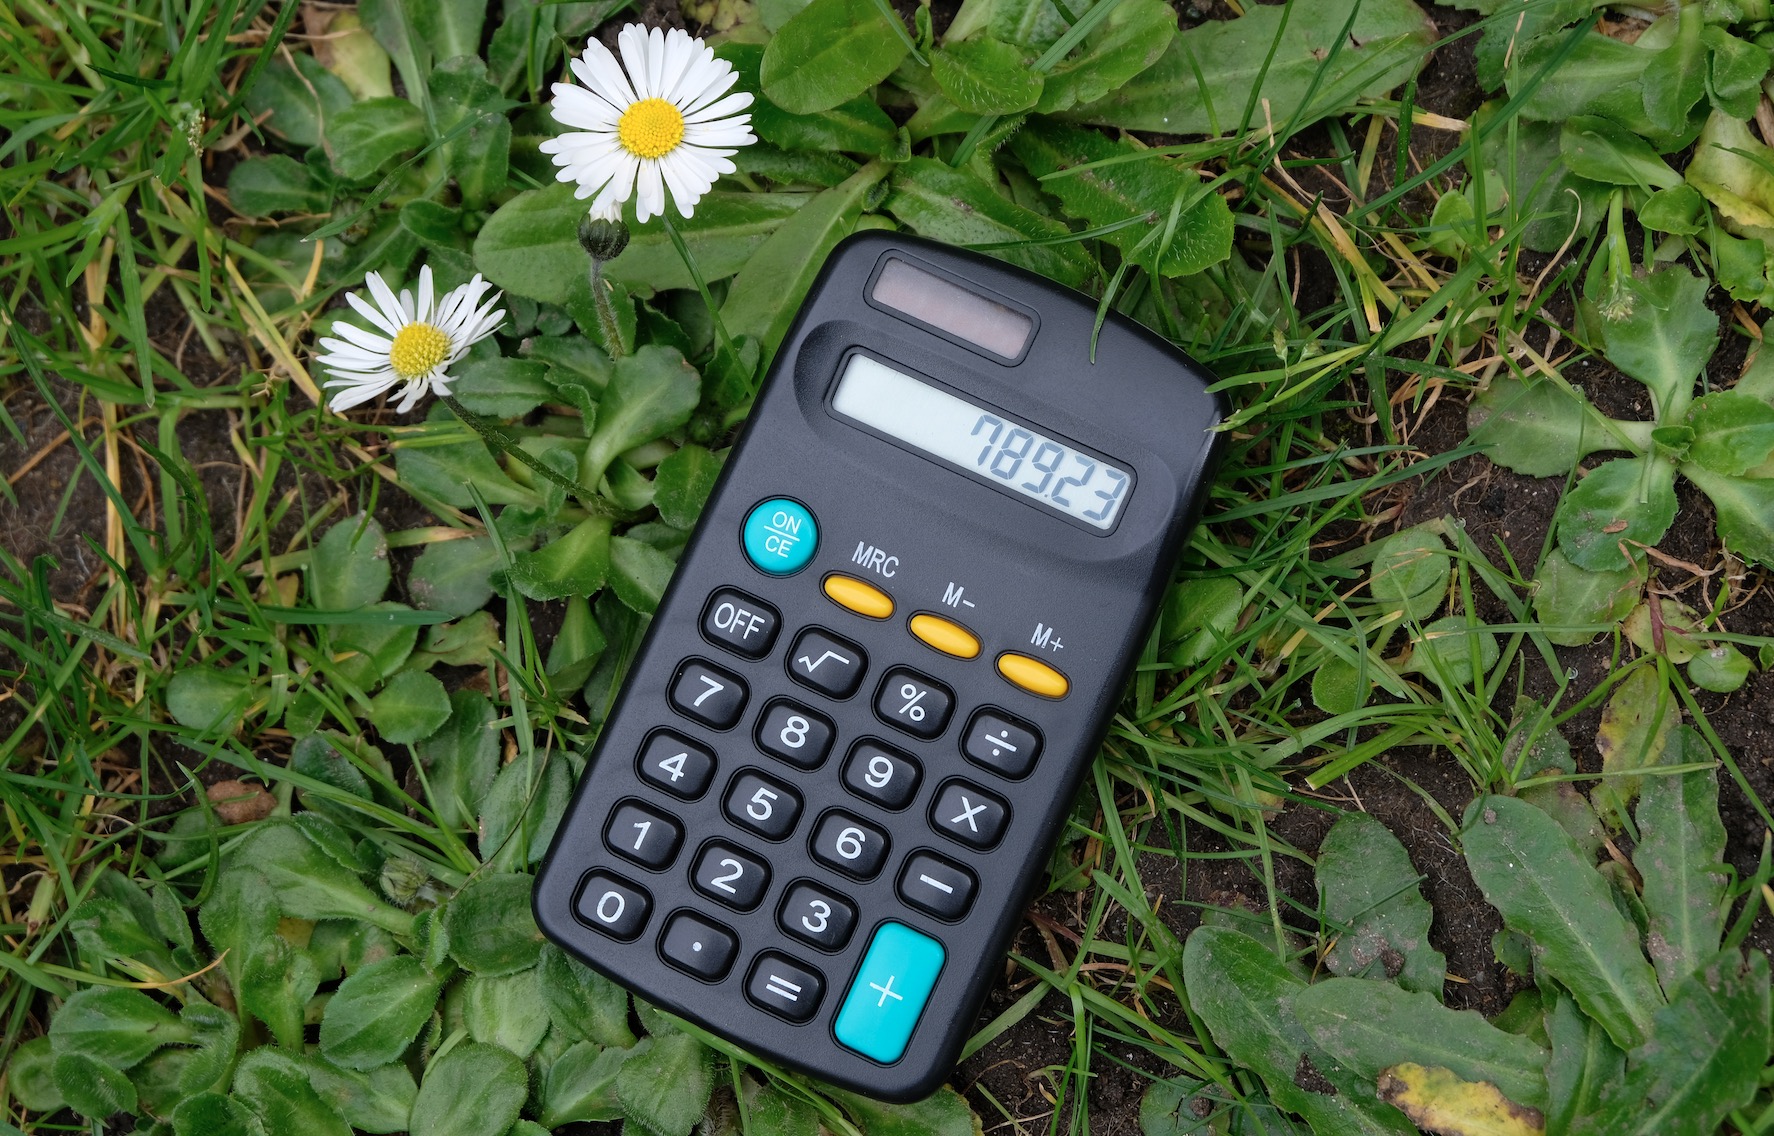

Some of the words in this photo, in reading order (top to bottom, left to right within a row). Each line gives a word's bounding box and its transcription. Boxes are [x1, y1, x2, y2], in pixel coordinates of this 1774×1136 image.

[970, 414, 1126, 521] 789.23
[768, 511, 802, 535] ON
[765, 534, 794, 558] CE
[851, 540, 900, 578] MRC
[713, 602, 766, 640] OFF
[1030, 622, 1064, 652] M+
[693, 674, 725, 707] 7
[779, 715, 810, 749] 8
[658, 752, 688, 782] 4
[864, 755, 894, 788] 9
[746, 786, 779, 821] 5
[633, 820, 652, 851] 1
[835, 826, 866, 860] 6
[710, 858, 744, 894] 2
[596, 890, 626, 924] 0
[801, 899, 832, 933] 3
